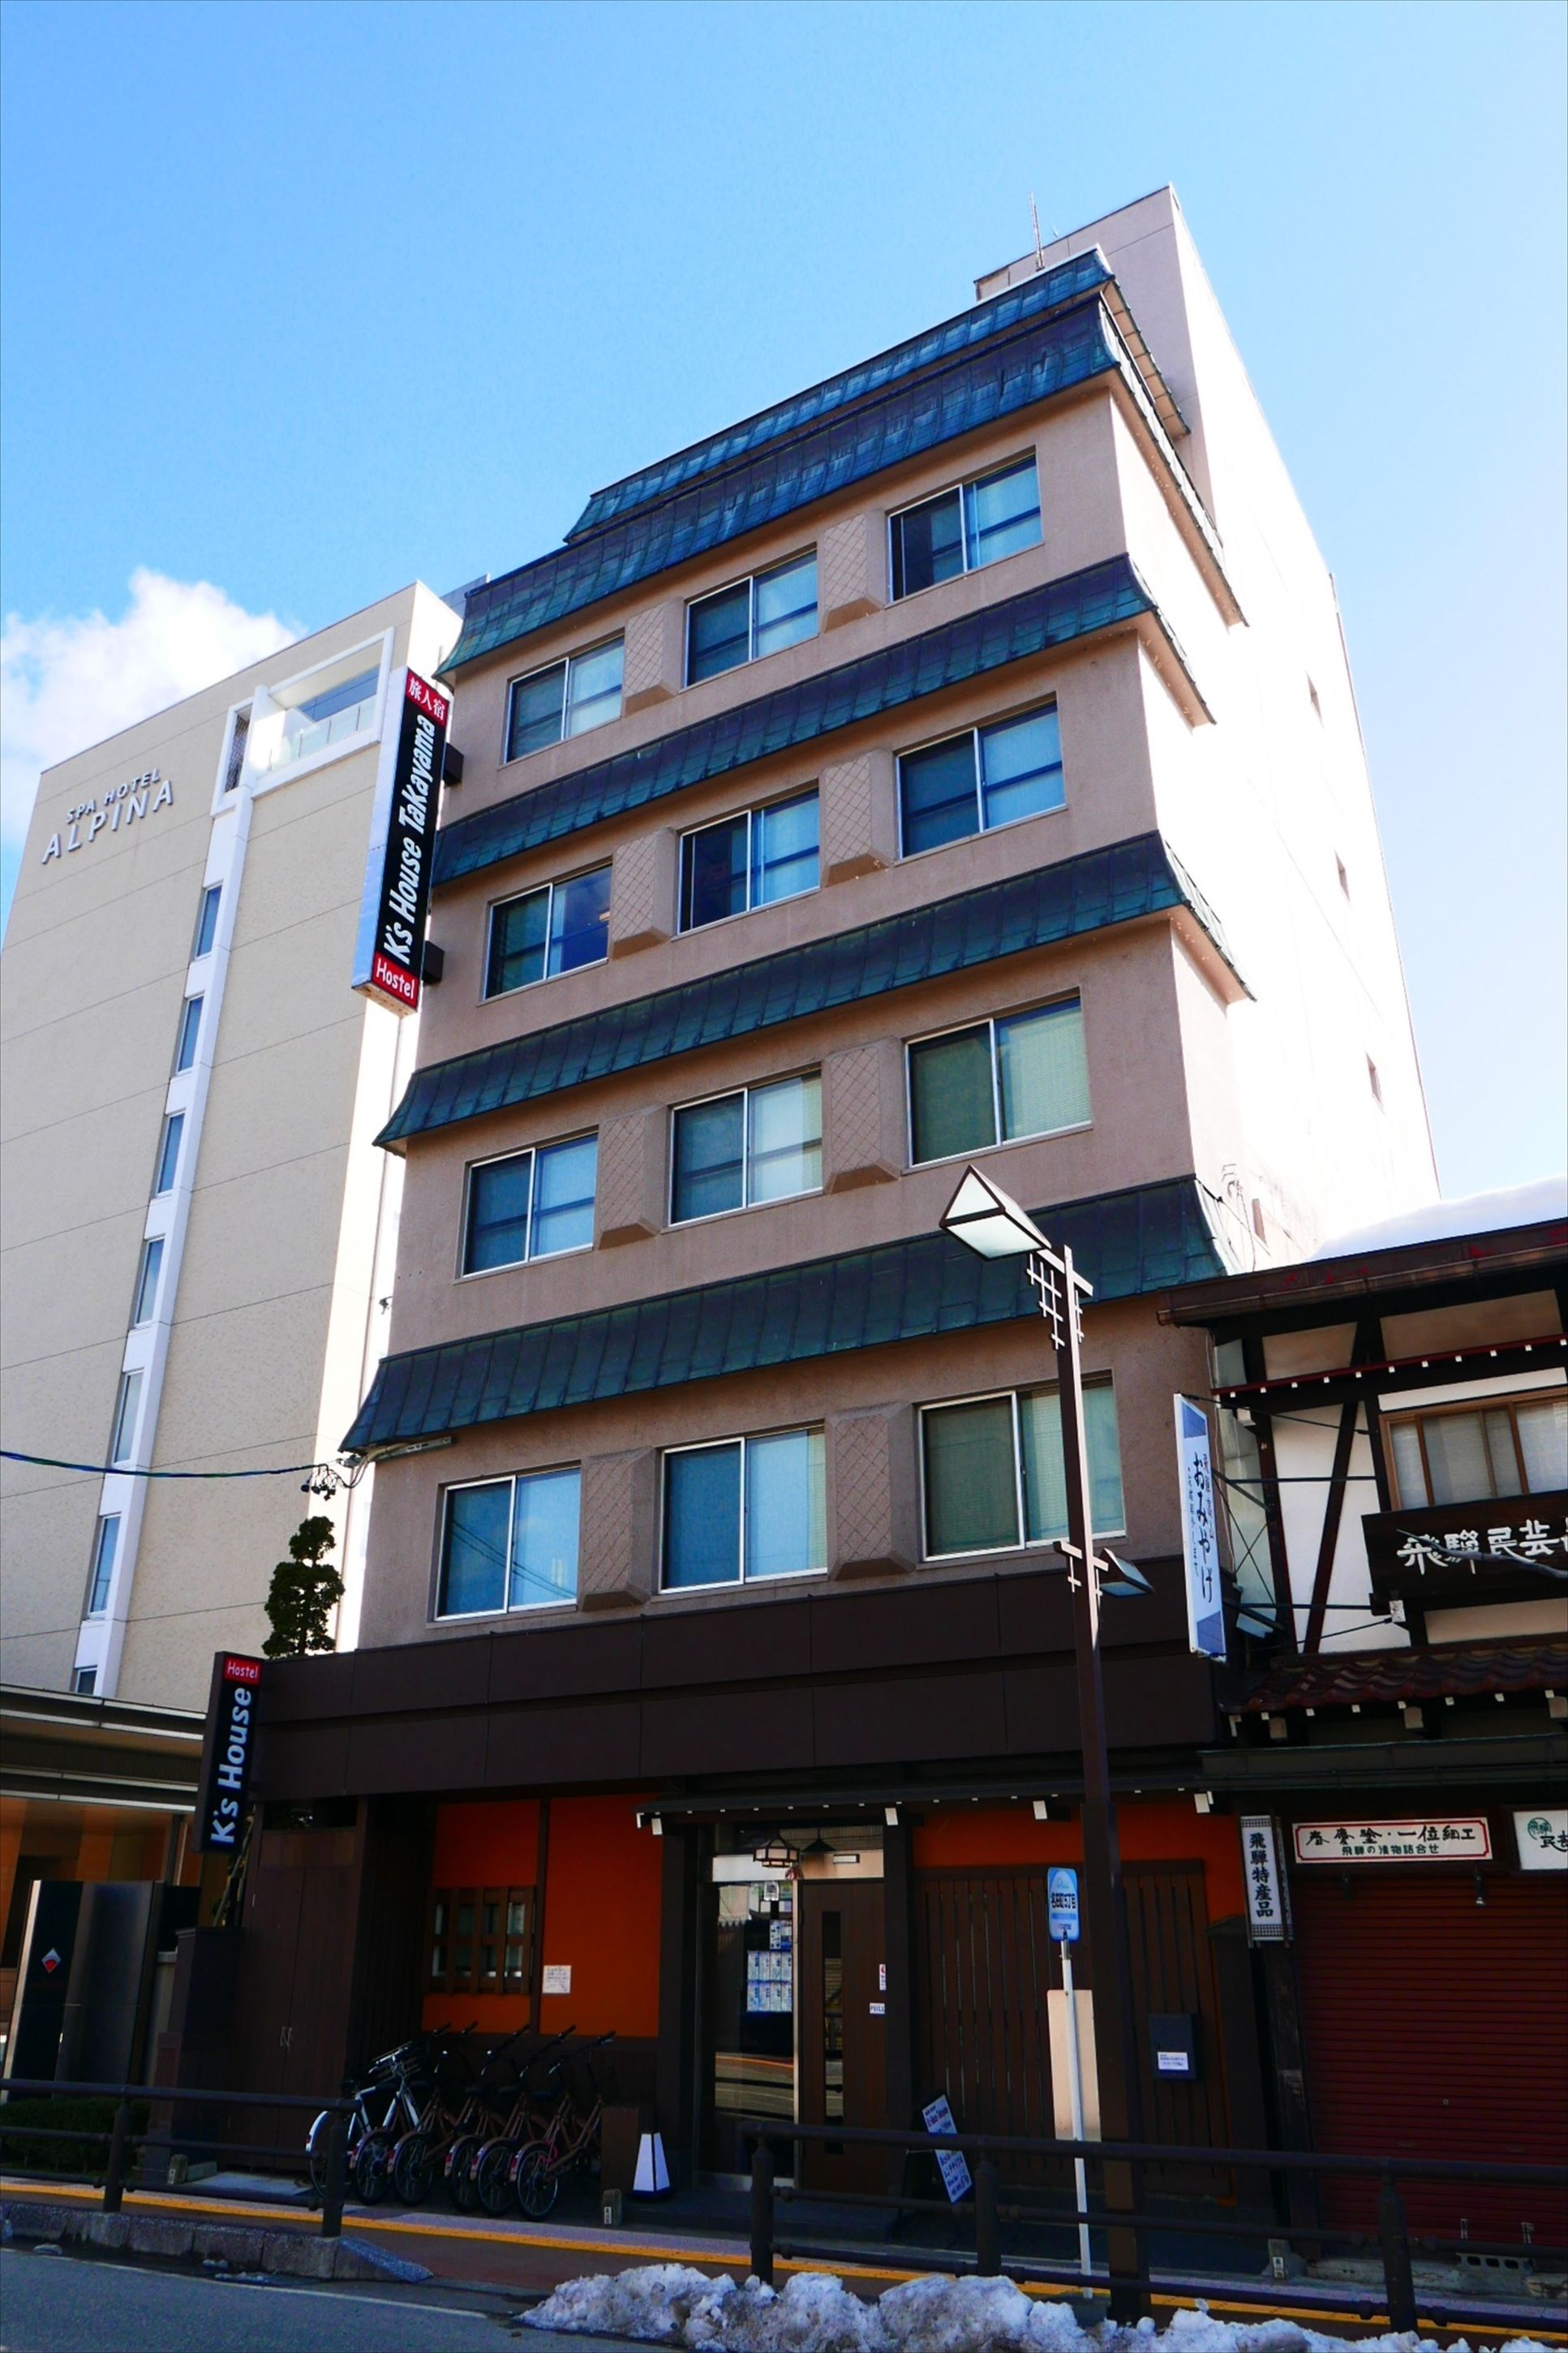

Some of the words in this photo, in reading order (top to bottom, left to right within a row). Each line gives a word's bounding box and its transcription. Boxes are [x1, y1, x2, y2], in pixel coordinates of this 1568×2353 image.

[408, 677, 445, 721] 旅人宿
[66, 799, 96, 825] SPA
[103, 768, 161, 807] HOTEL
[398, 714, 436, 835] Takayama
[41, 780, 174, 865] ALPINA
[389, 837, 423, 923] House
[383, 923, 411, 966] K's
[376, 957, 416, 1000] Hostel
[227, 1661, 259, 1679] Hostel
[217, 1687, 252, 1790] House
[210, 1797, 239, 1844] K's
